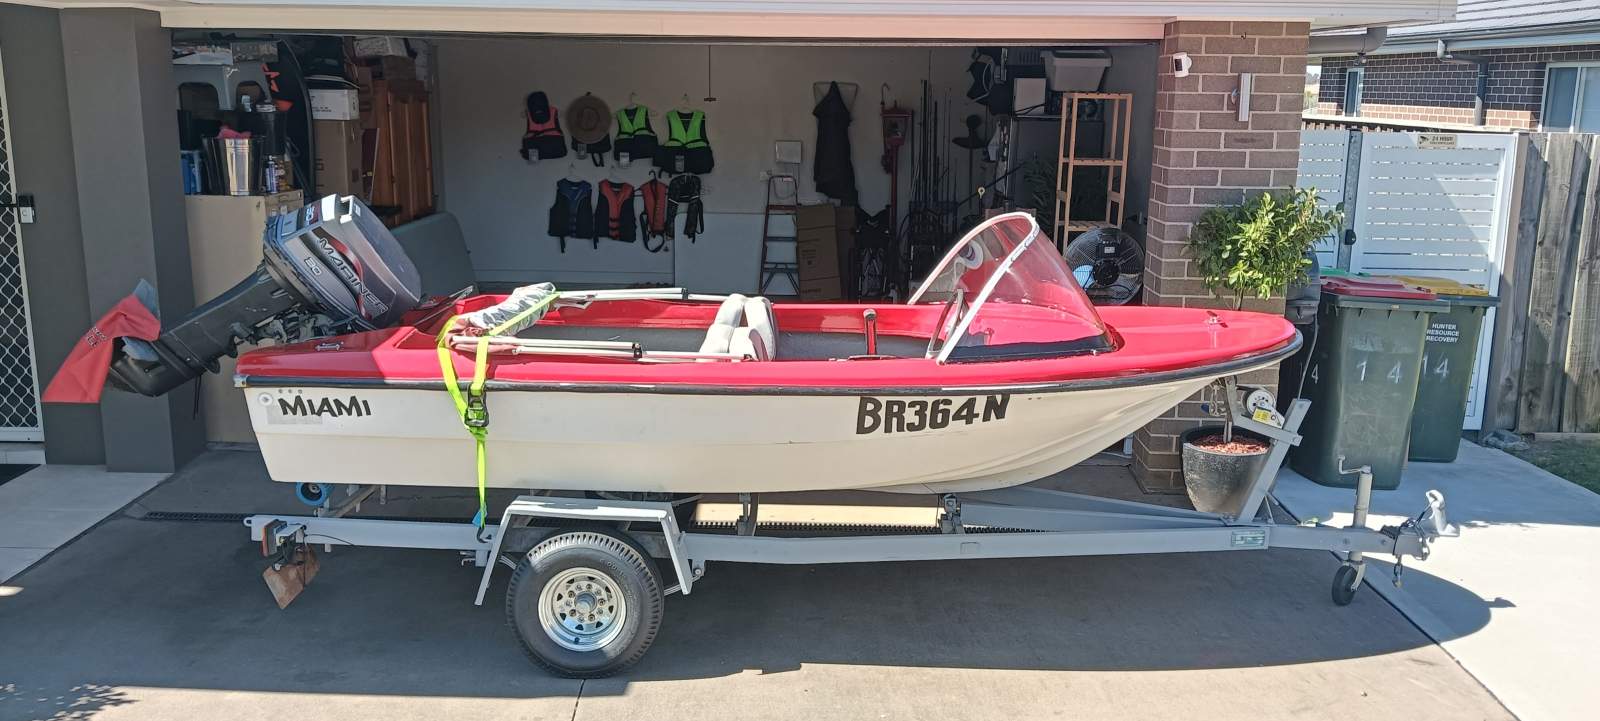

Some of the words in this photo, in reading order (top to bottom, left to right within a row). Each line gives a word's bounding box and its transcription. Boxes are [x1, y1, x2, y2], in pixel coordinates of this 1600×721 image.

[319, 237, 389, 314] MARINER
[1426, 329, 1460, 337] RESOURCE
[1426, 335, 1459, 343] RECOVERY
[278, 395, 371, 417] MIAMI
[856, 393, 1010, 434] BR364N
